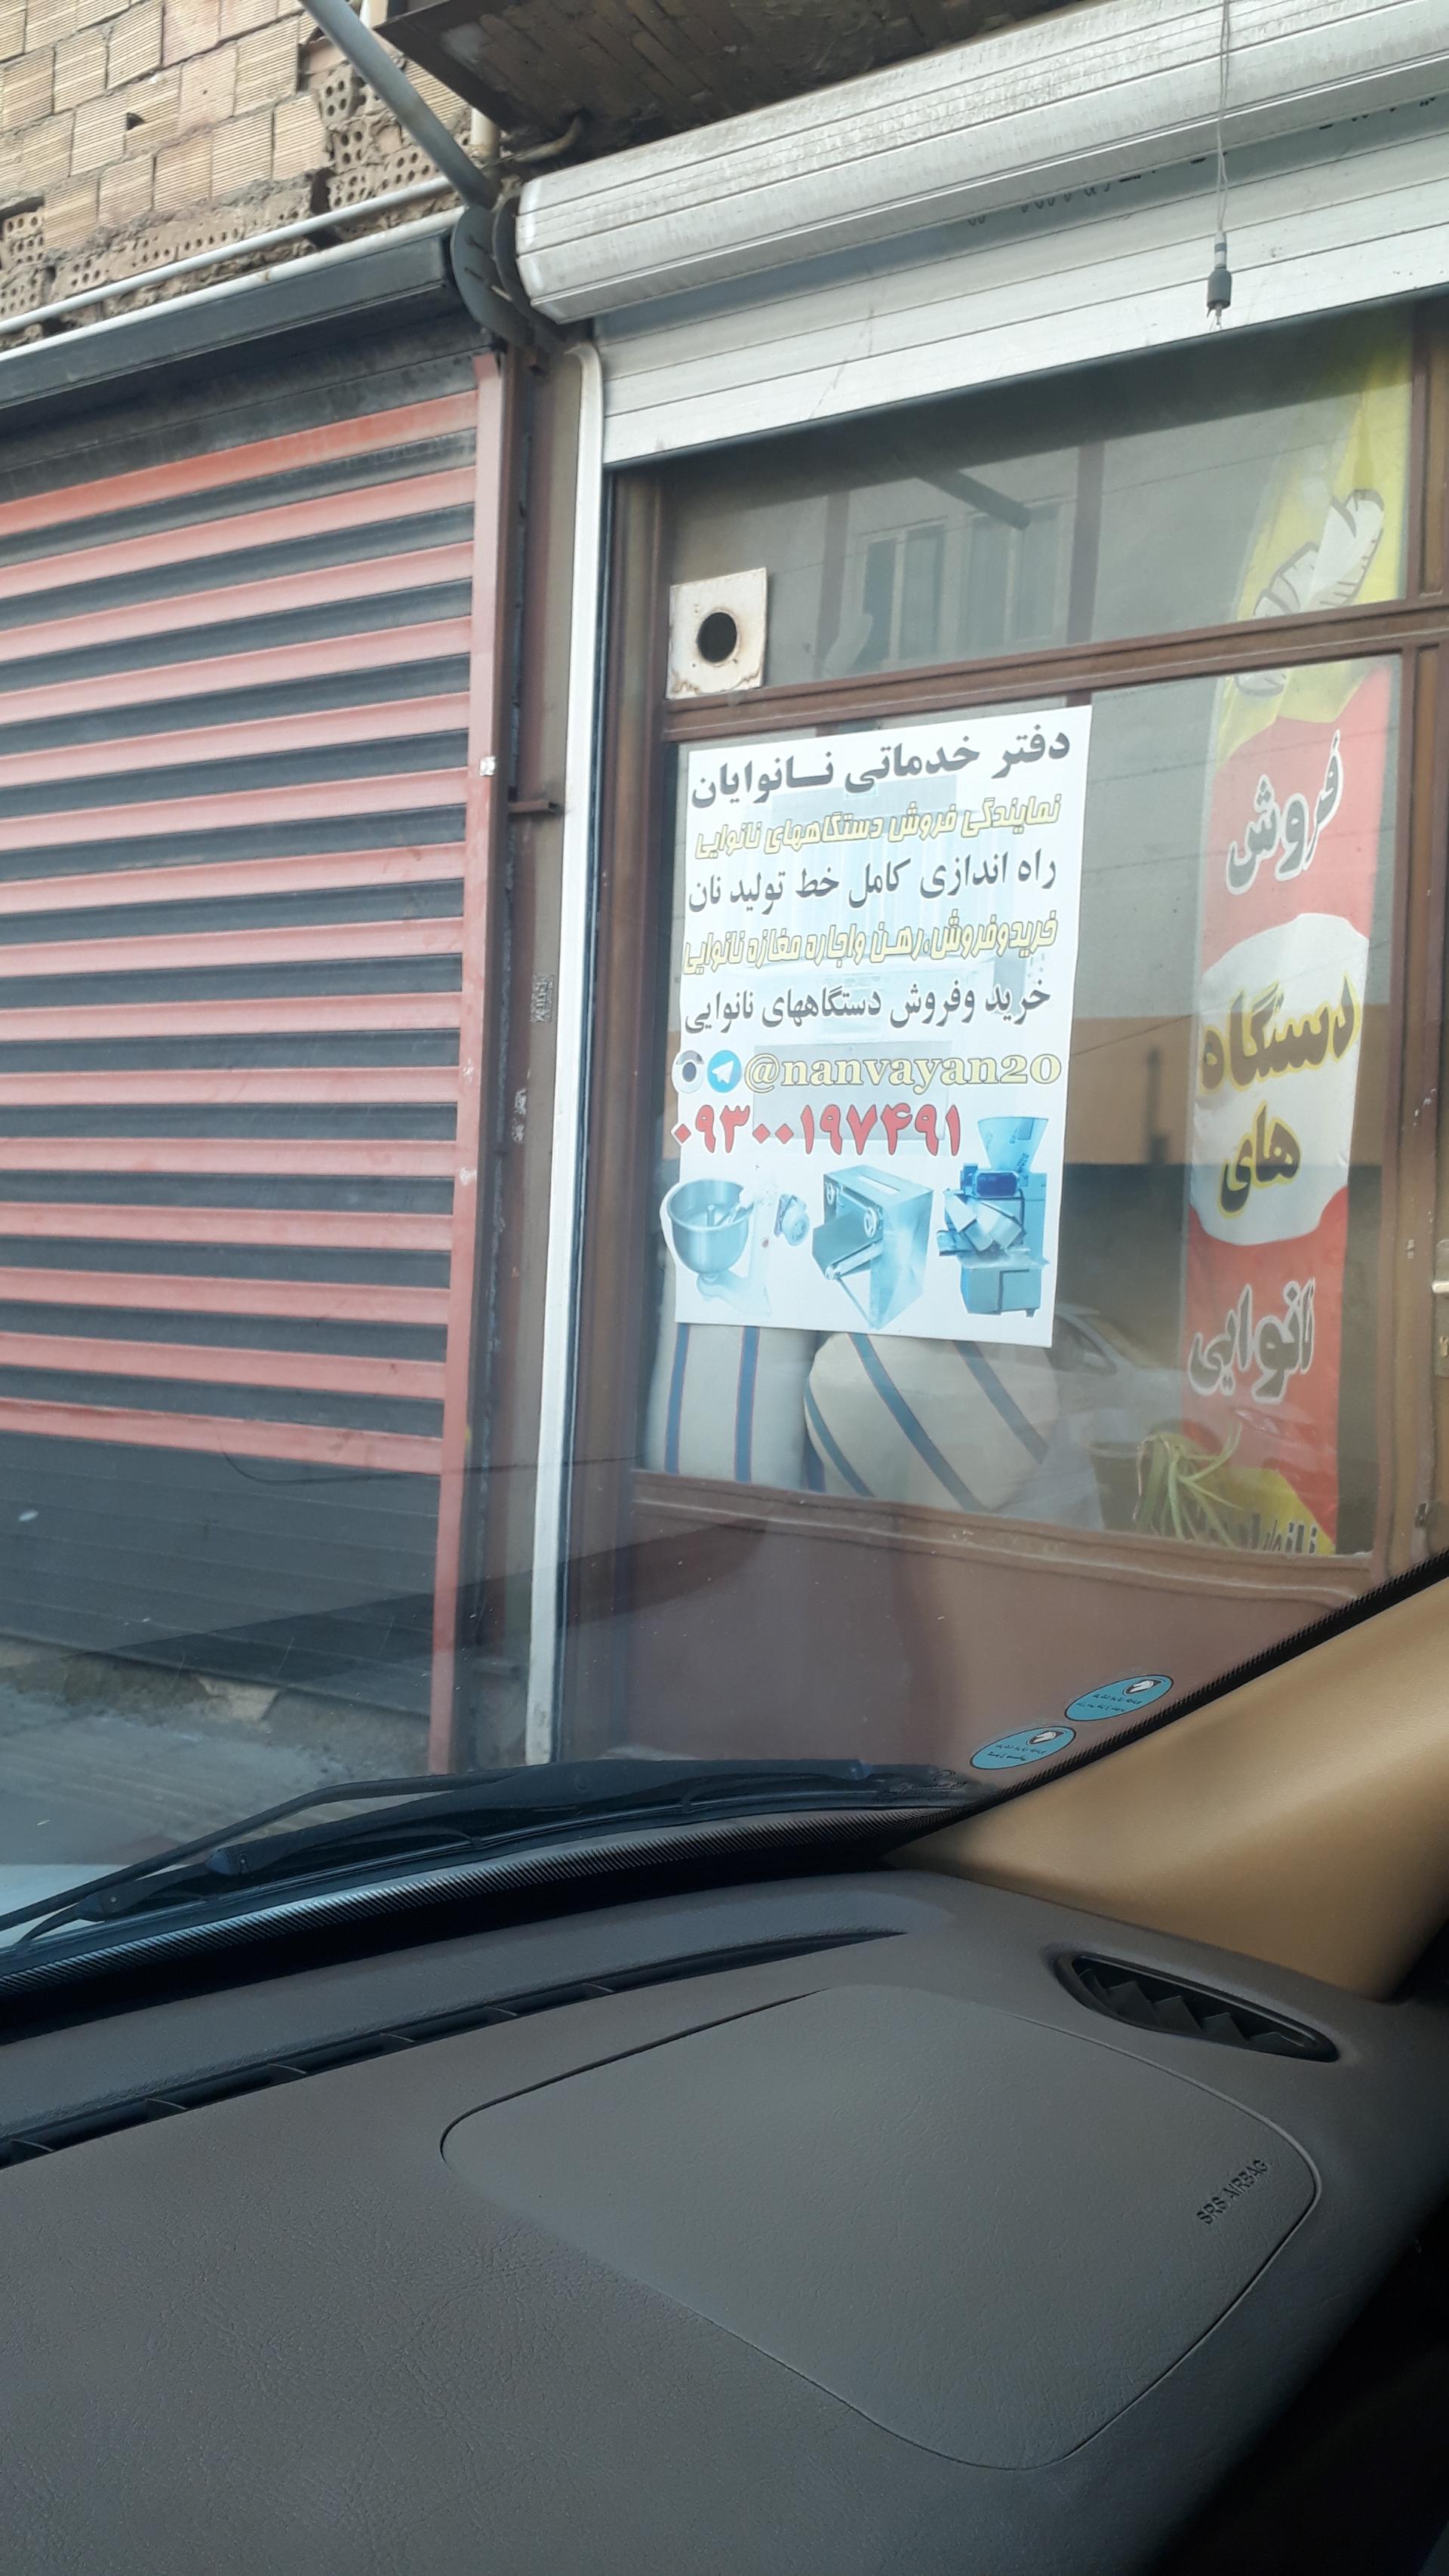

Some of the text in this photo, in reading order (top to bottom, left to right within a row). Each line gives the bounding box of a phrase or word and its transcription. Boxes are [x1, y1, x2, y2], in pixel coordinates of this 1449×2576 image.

[844, 735, 980, 793] خدماتی
[991, 724, 1070, 779] دفتر
[694, 793, 1062, 859] نمایندگی فروش دستگاههای نانوایی
[688, 848, 1056, 915] راه اندازی کامل خط تولید نان
[682, 930, 746, 974] نانوایی
[746, 928, 801, 969] مغازه
[685, 989, 753, 1033] نانوایی
[761, 986, 882, 1027] دستگاههای
[985, 979, 1051, 1025] خرید
[743, 1053, 1063, 1094] @nanvayan20
[672, 1103, 961, 1156] ۰۹۳۰۰۱۹۷۴۹۱
[1218, 1100, 1302, 1219] های
[1196, 2159, 1269, 2225] SRS AIRBAG
